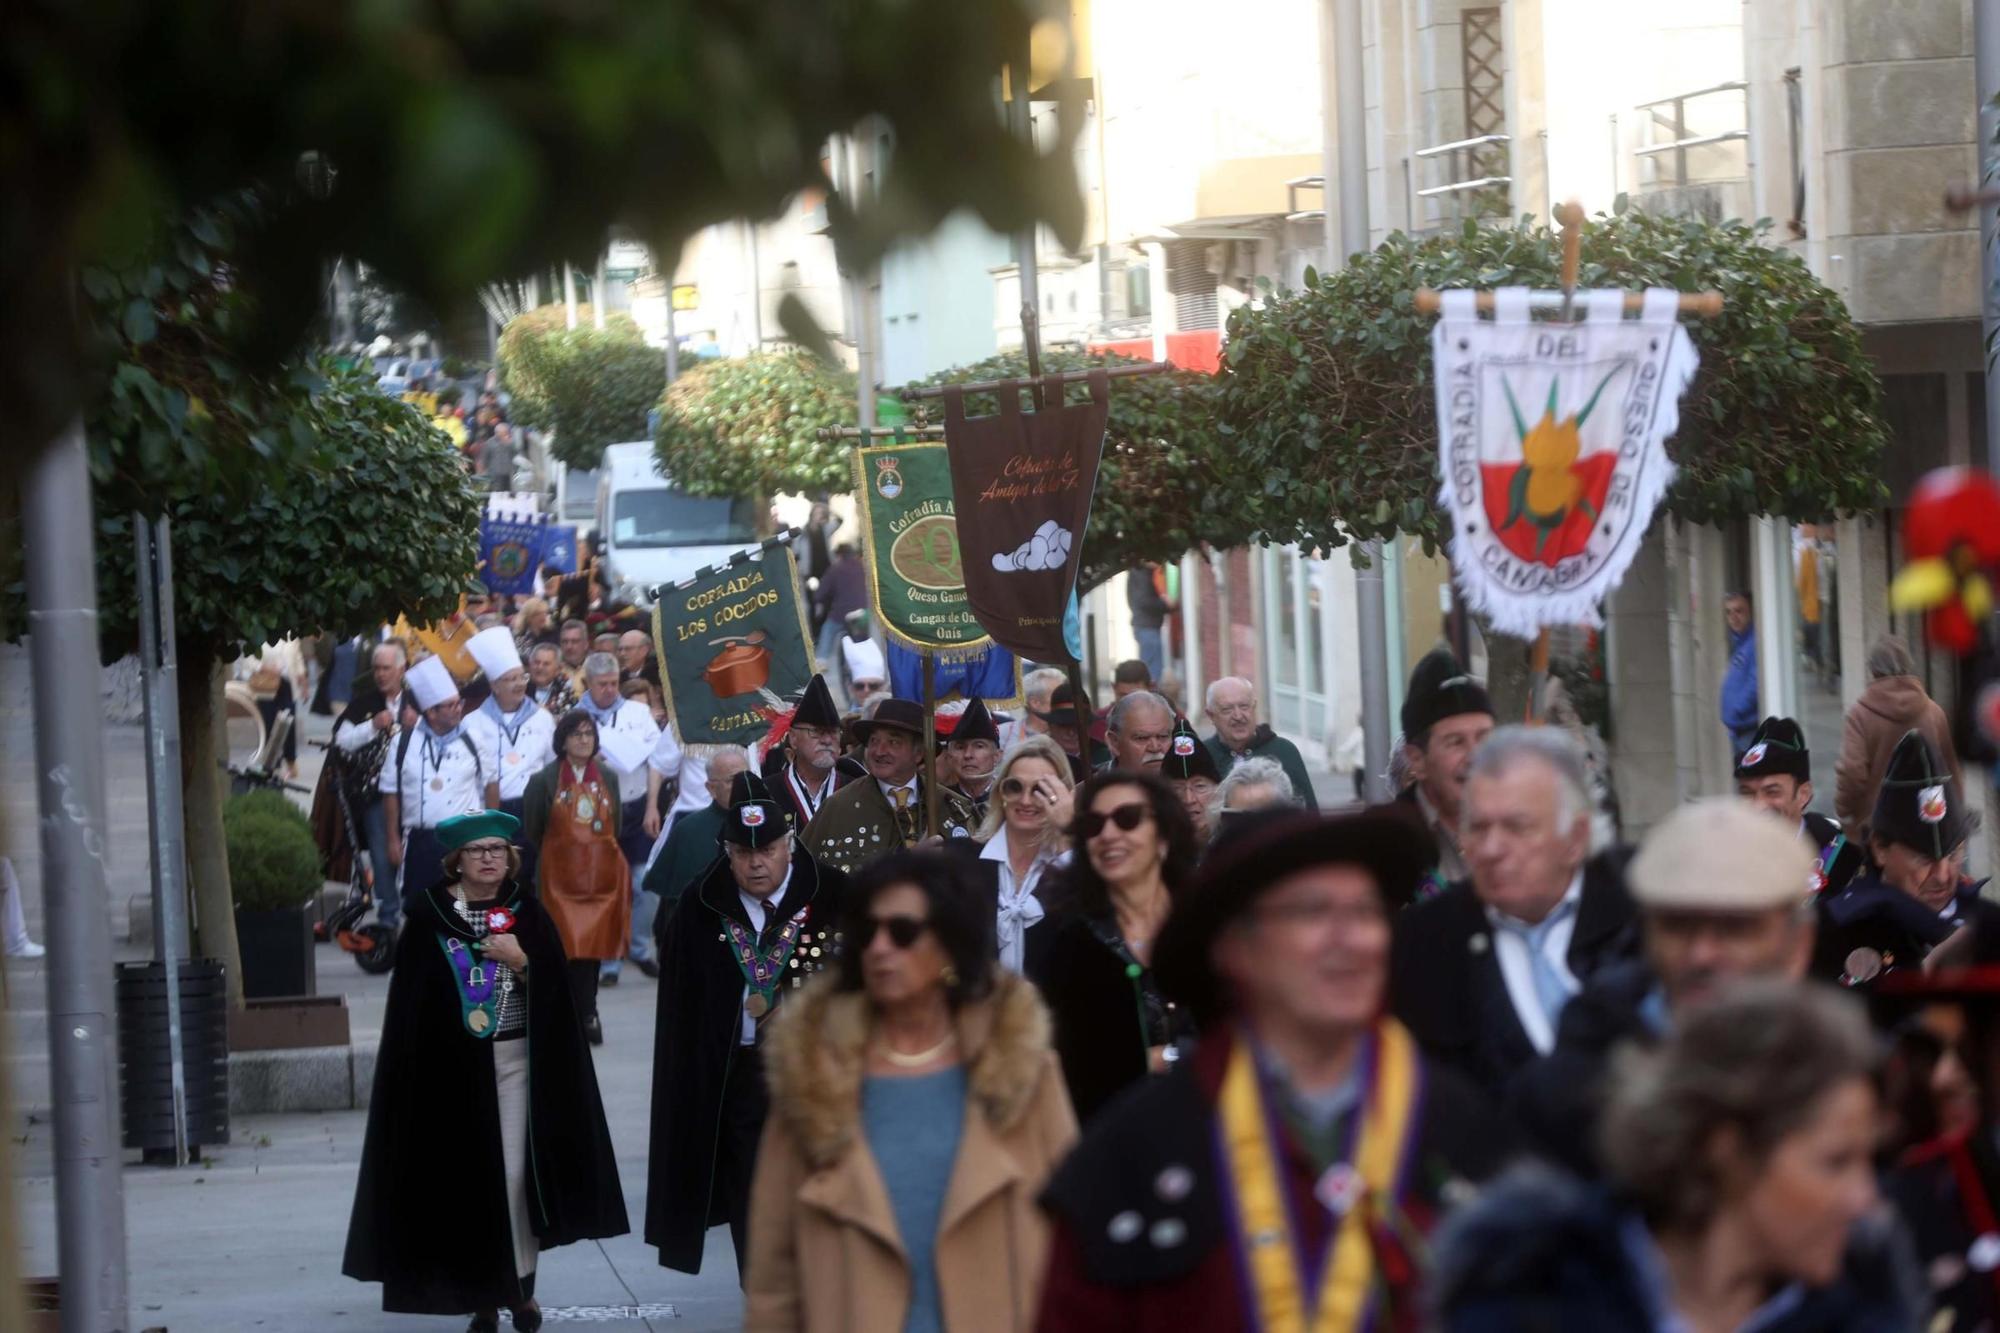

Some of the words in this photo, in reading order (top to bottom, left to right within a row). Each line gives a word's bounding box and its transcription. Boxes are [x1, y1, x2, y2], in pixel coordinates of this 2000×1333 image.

[1536, 333, 1586, 358] DEL
[1620, 361, 1657, 460] QUESO
[1608, 472, 1632, 510] DE
[889, 499, 943, 534] Cofradía
[907, 586, 938, 603] Queso
[677, 618, 707, 641] LOS
[714, 588, 779, 626] COCIDOS
[909, 612, 946, 626] Cangas
[948, 612, 960, 624] de
[936, 626, 962, 639] Onís
